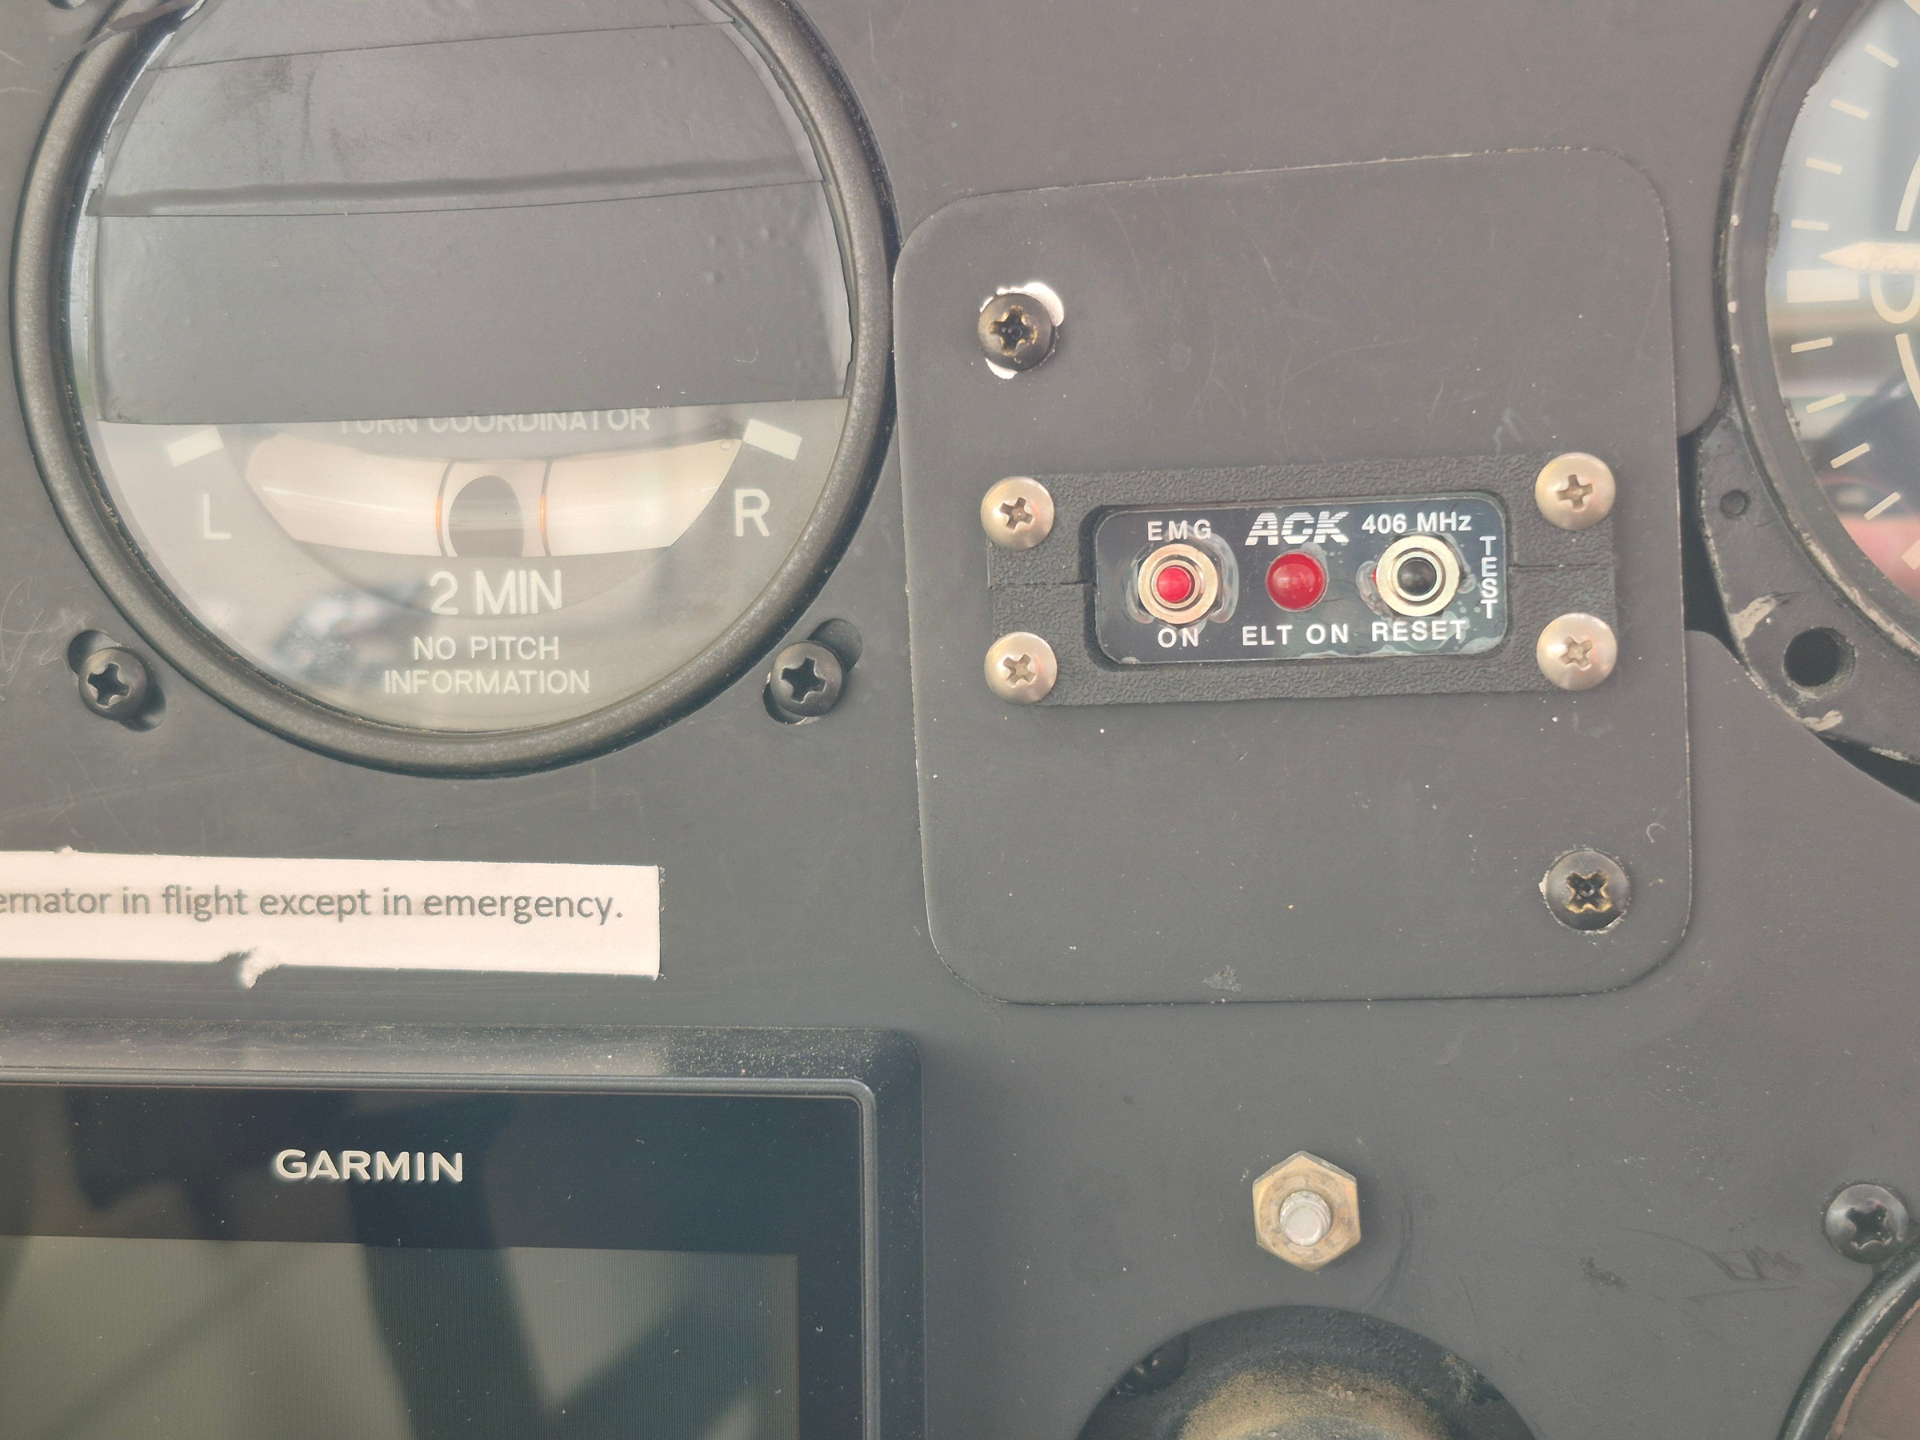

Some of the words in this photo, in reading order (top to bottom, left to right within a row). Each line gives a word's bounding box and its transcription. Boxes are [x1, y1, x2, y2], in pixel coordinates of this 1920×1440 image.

[202, 493, 232, 541] L
[734, 488, 771, 538] R
[1361, 513, 1407, 535] 406
[1416, 512, 1472, 533] MHz
[1147, 519, 1212, 541] EMG
[1244, 511, 1350, 546] ACK
[1479, 535, 1499, 620] TEST
[429, 571, 460, 616] 2
[475, 569, 563, 615] MIN
[1157, 627, 1199, 648] ON
[1242, 624, 1292, 646] ELT
[1305, 623, 1349, 645] ON
[1371, 619, 1467, 642] RESET
[412, 635, 457, 661] NO
[470, 635, 560, 661] PITCH
[384, 669, 591, 695] INFORMATION
[122, 885, 151, 915] in
[161, 884, 249, 923] flight
[259, 889, 372, 923] except
[383, 887, 413, 917] in
[423, 894, 624, 926] emergency.
[276, 1149, 463, 1182] GARMIN
